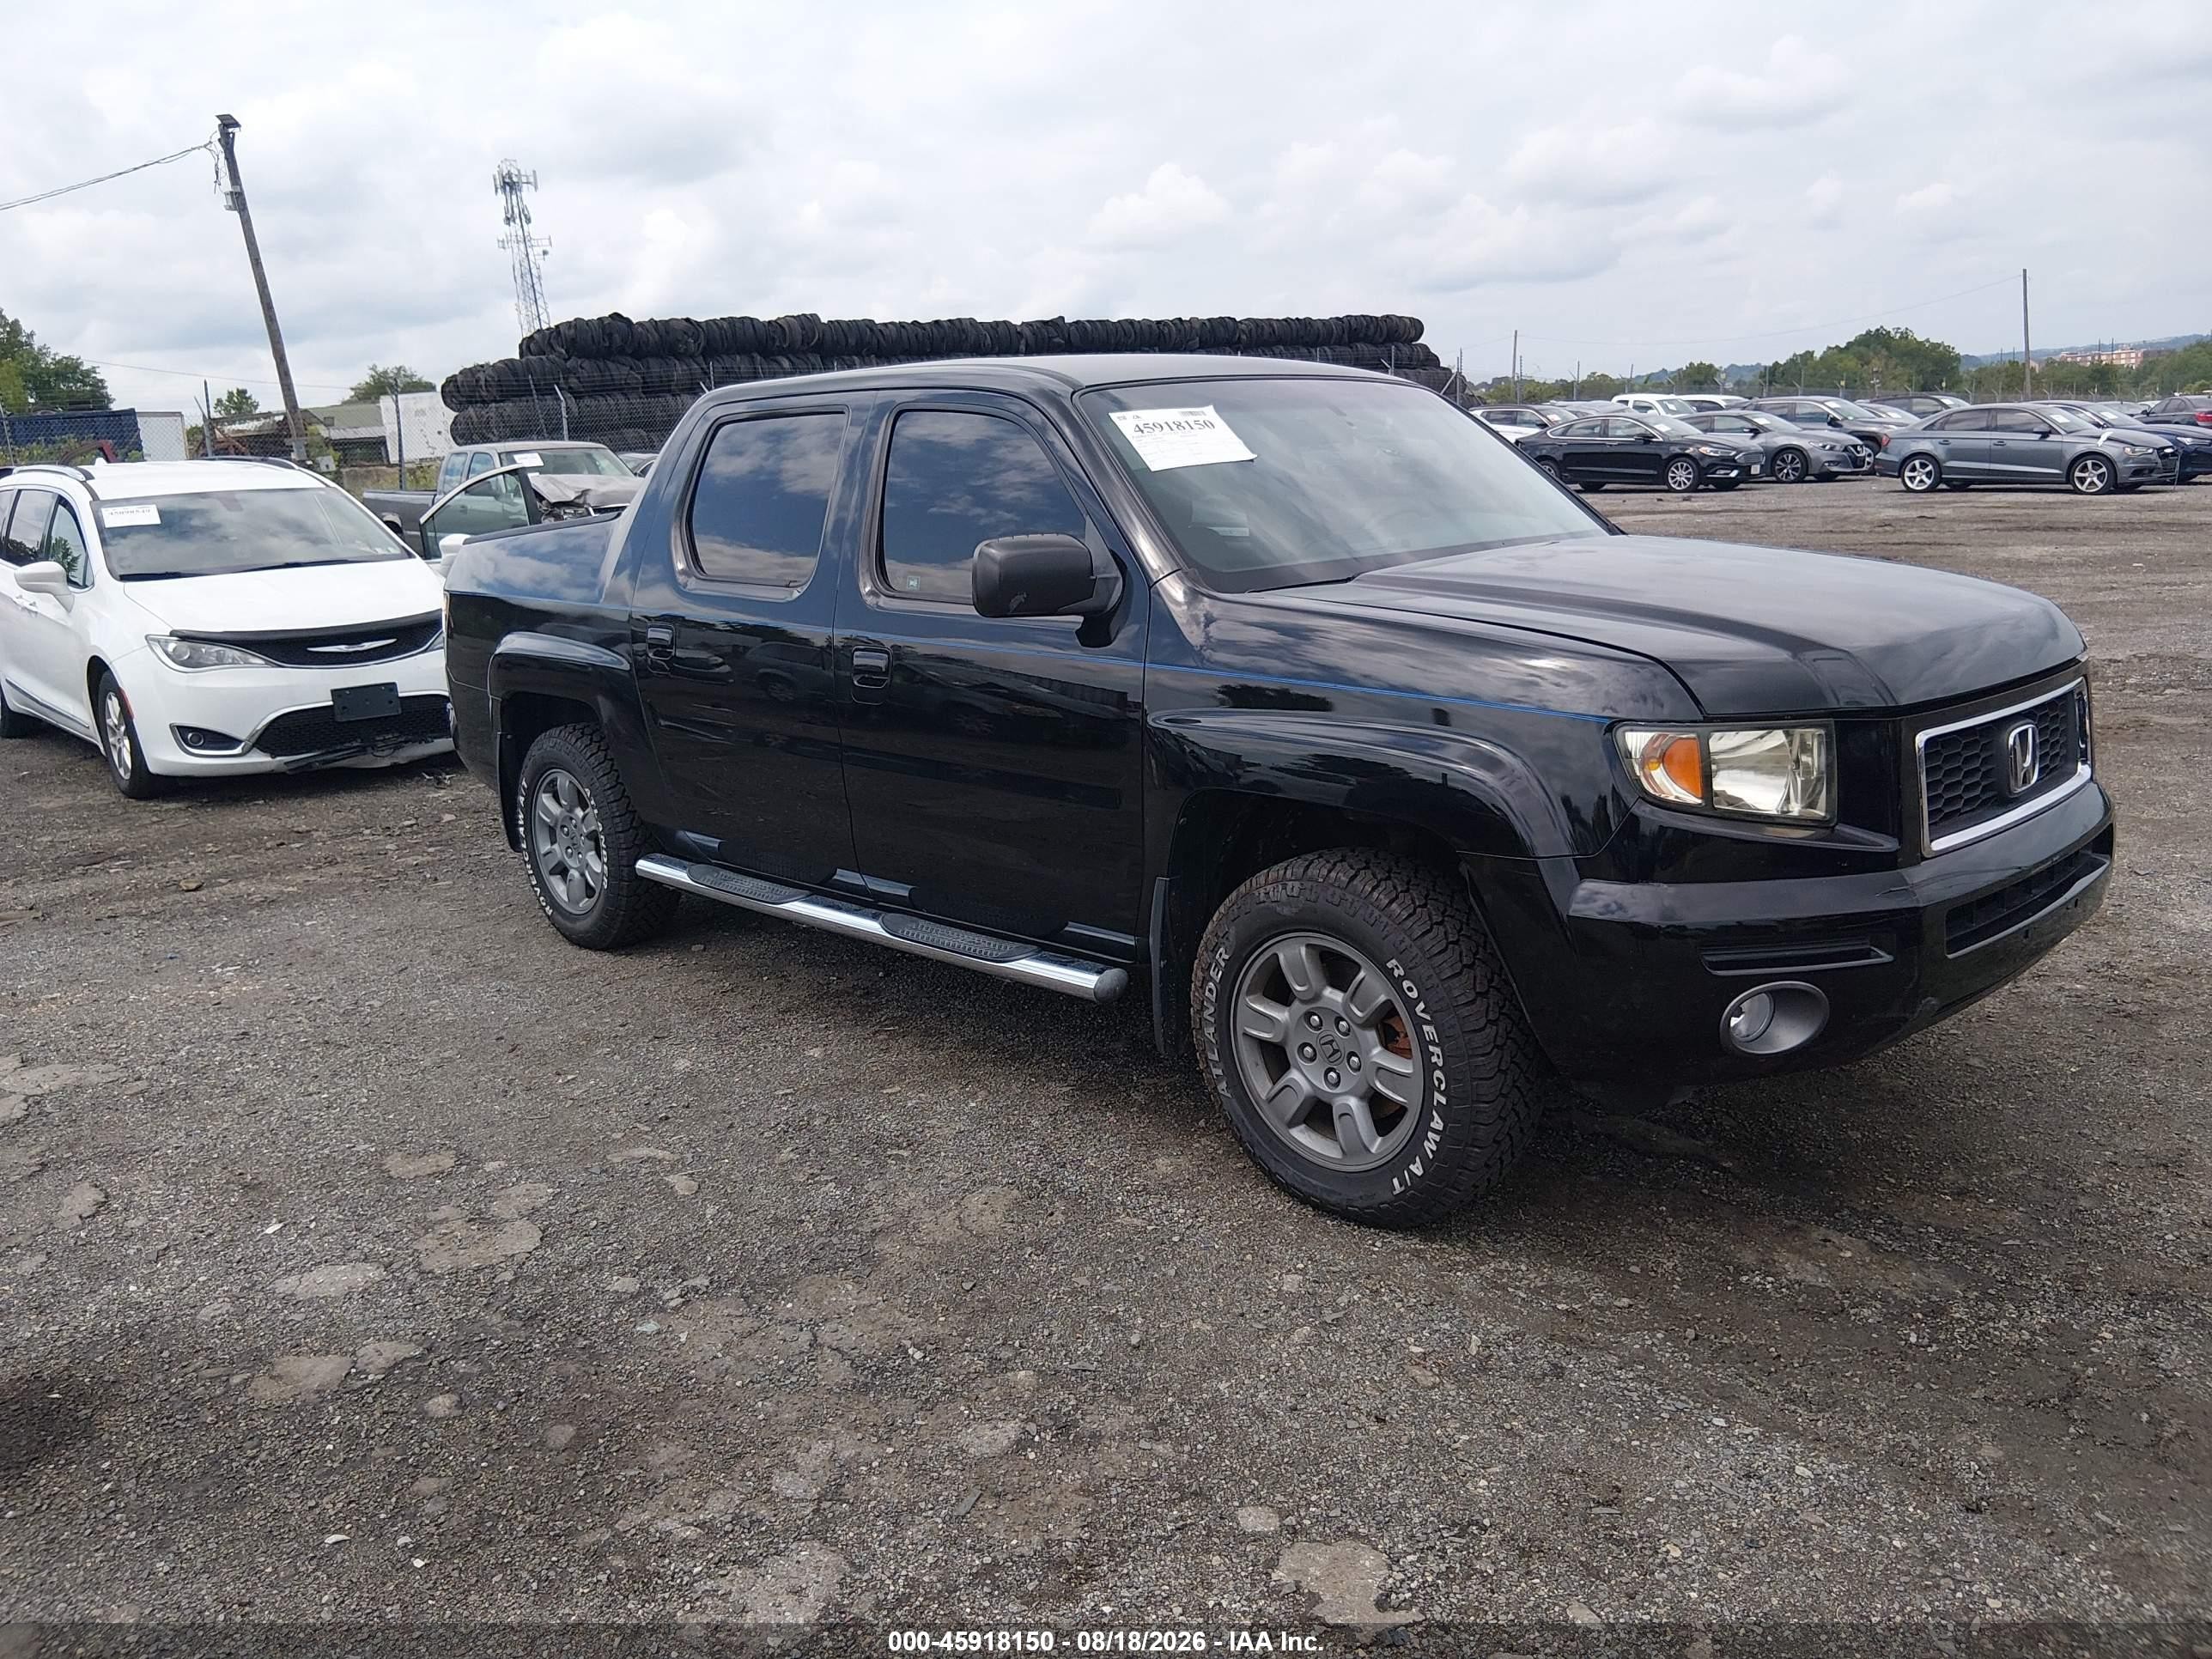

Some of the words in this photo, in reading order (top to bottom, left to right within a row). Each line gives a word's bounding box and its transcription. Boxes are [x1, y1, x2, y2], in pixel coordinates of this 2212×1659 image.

[1133, 419, 1215, 434] 45918150
[1204, 947, 1232, 1098] ATLANDER
[1387, 959, 1448, 1160] ROVERCLAW
[1392, 1156, 1425, 1195] A/T
